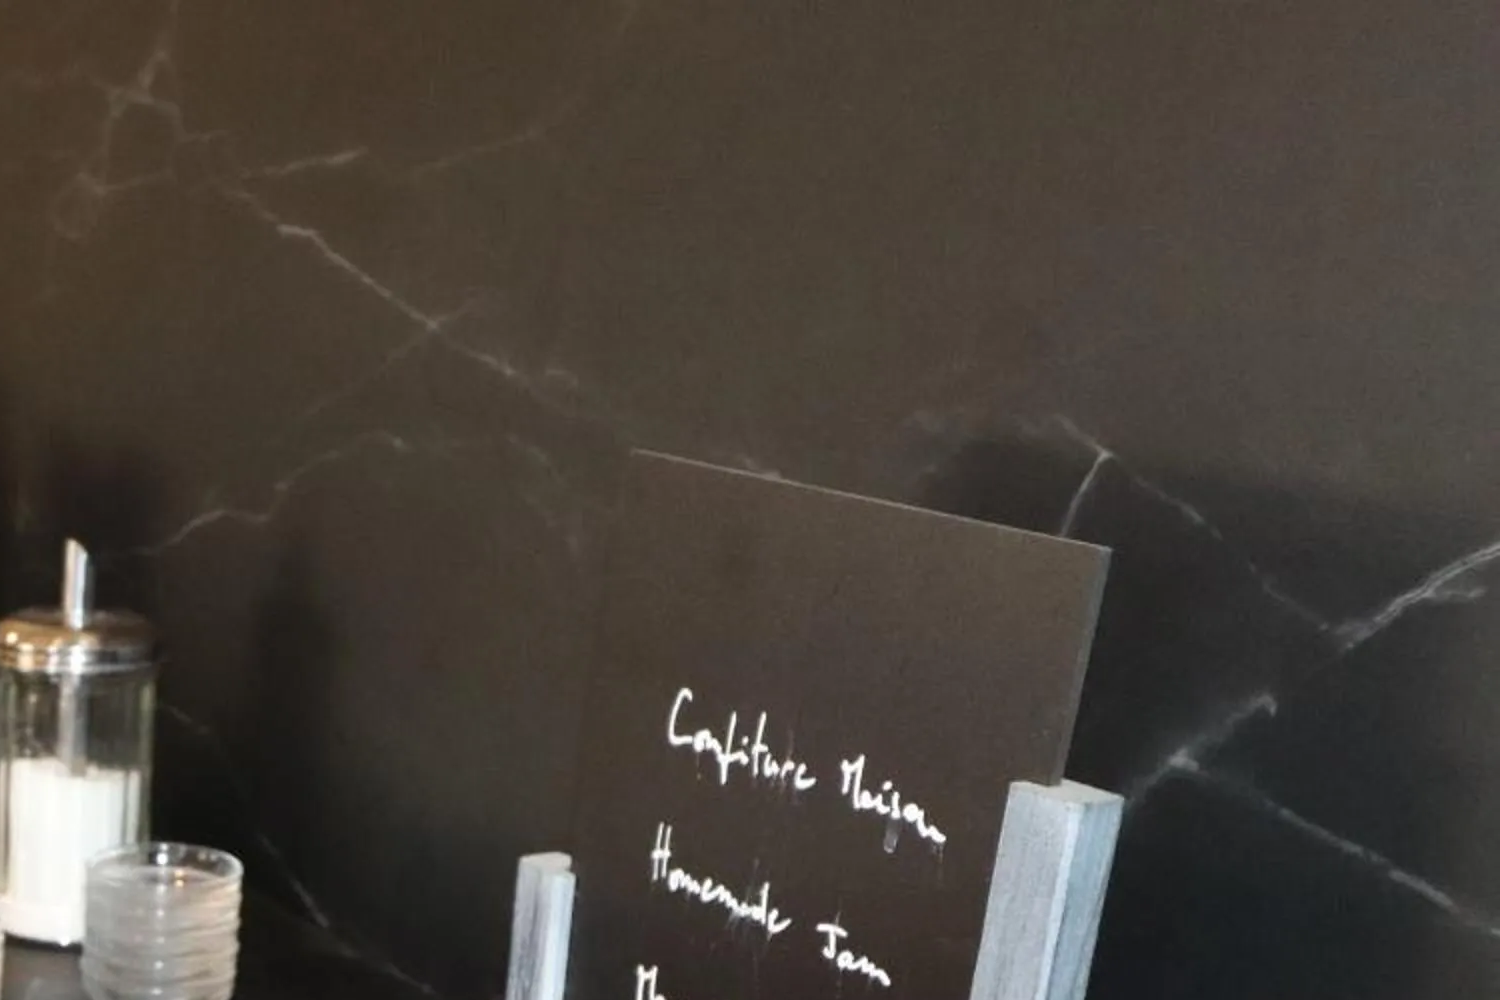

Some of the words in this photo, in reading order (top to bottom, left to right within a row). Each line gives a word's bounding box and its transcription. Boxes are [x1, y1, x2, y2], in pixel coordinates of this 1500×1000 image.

[667, 687, 818, 786] Confiture
[651, 821, 793, 934] Homemade
[815, 922, 892, 988] Jam
